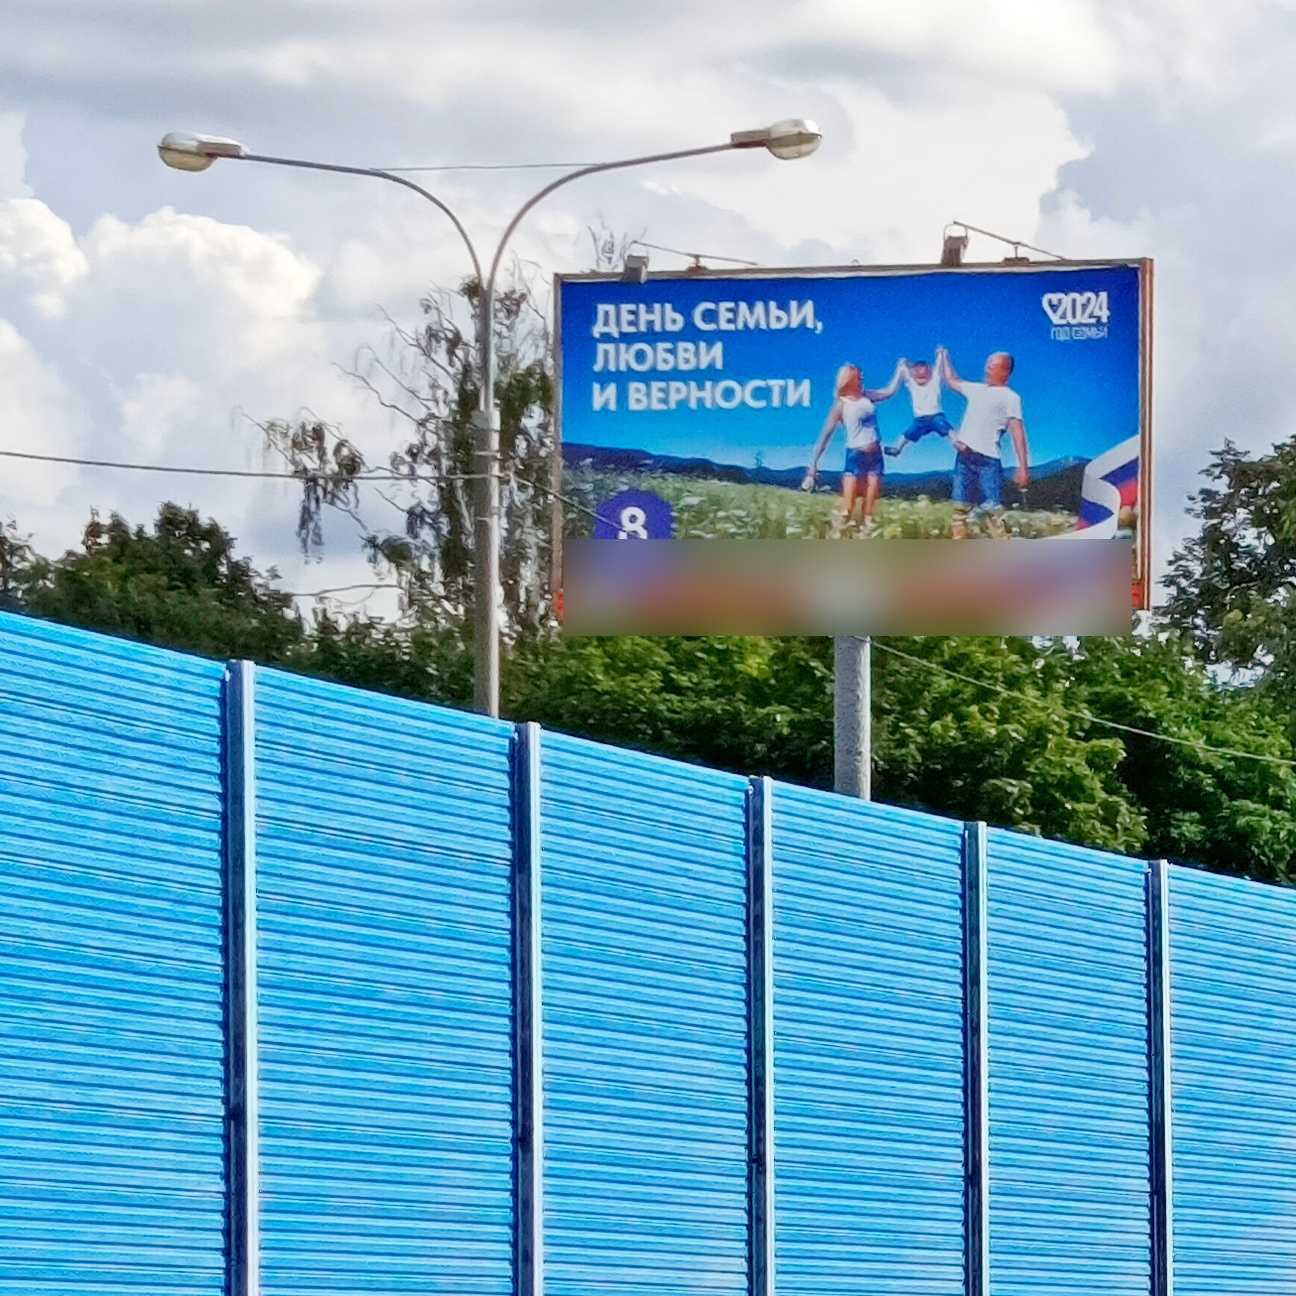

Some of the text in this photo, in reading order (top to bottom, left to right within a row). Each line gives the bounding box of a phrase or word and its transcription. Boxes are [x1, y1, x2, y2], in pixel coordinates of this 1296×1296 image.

[592, 300, 823, 338] ДЕНЬ СЕМЬИ,
[1053, 291, 1110, 325] 2024
[592, 341, 724, 372] ЛЮБВИ
[592, 378, 811, 411] И ВЕРНОСТИ
